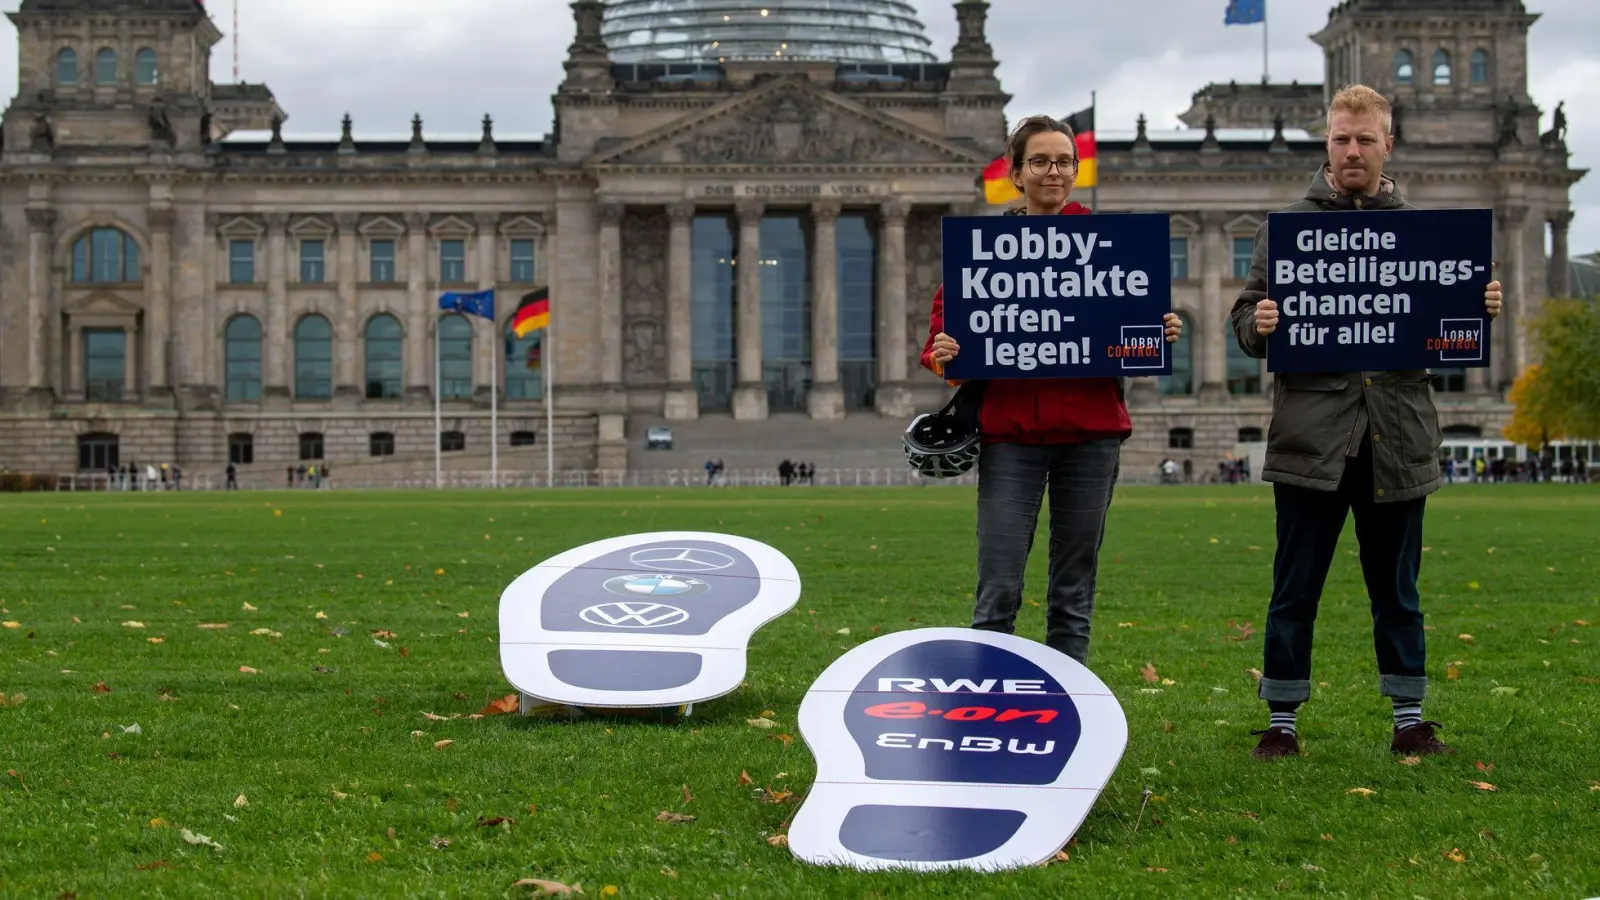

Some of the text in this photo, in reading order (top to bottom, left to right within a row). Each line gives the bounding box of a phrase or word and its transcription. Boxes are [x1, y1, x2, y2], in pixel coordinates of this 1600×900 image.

[972, 227, 1113, 265] Lobby-
[1296, 228, 1396, 252] Gleiche
[962, 265, 1149, 299] Kontakte
[1275, 256, 1485, 287] Beteiligungs-
[1282, 290, 1411, 316] chancen
[969, 304, 1075, 333] offen-
[1124, 337, 1160, 350] LOBBY
[1288, 321, 1395, 346] für alle!
[1427, 338, 1478, 350] CONTROL
[1444, 329, 1480, 342] LOBBY
[985, 337, 1091, 371] legen!
[1107, 345, 1160, 358] CONTROL
[580, 602, 689, 627] VW
[877, 677, 1047, 695] RWE
[875, 732, 1056, 755] EnBW
